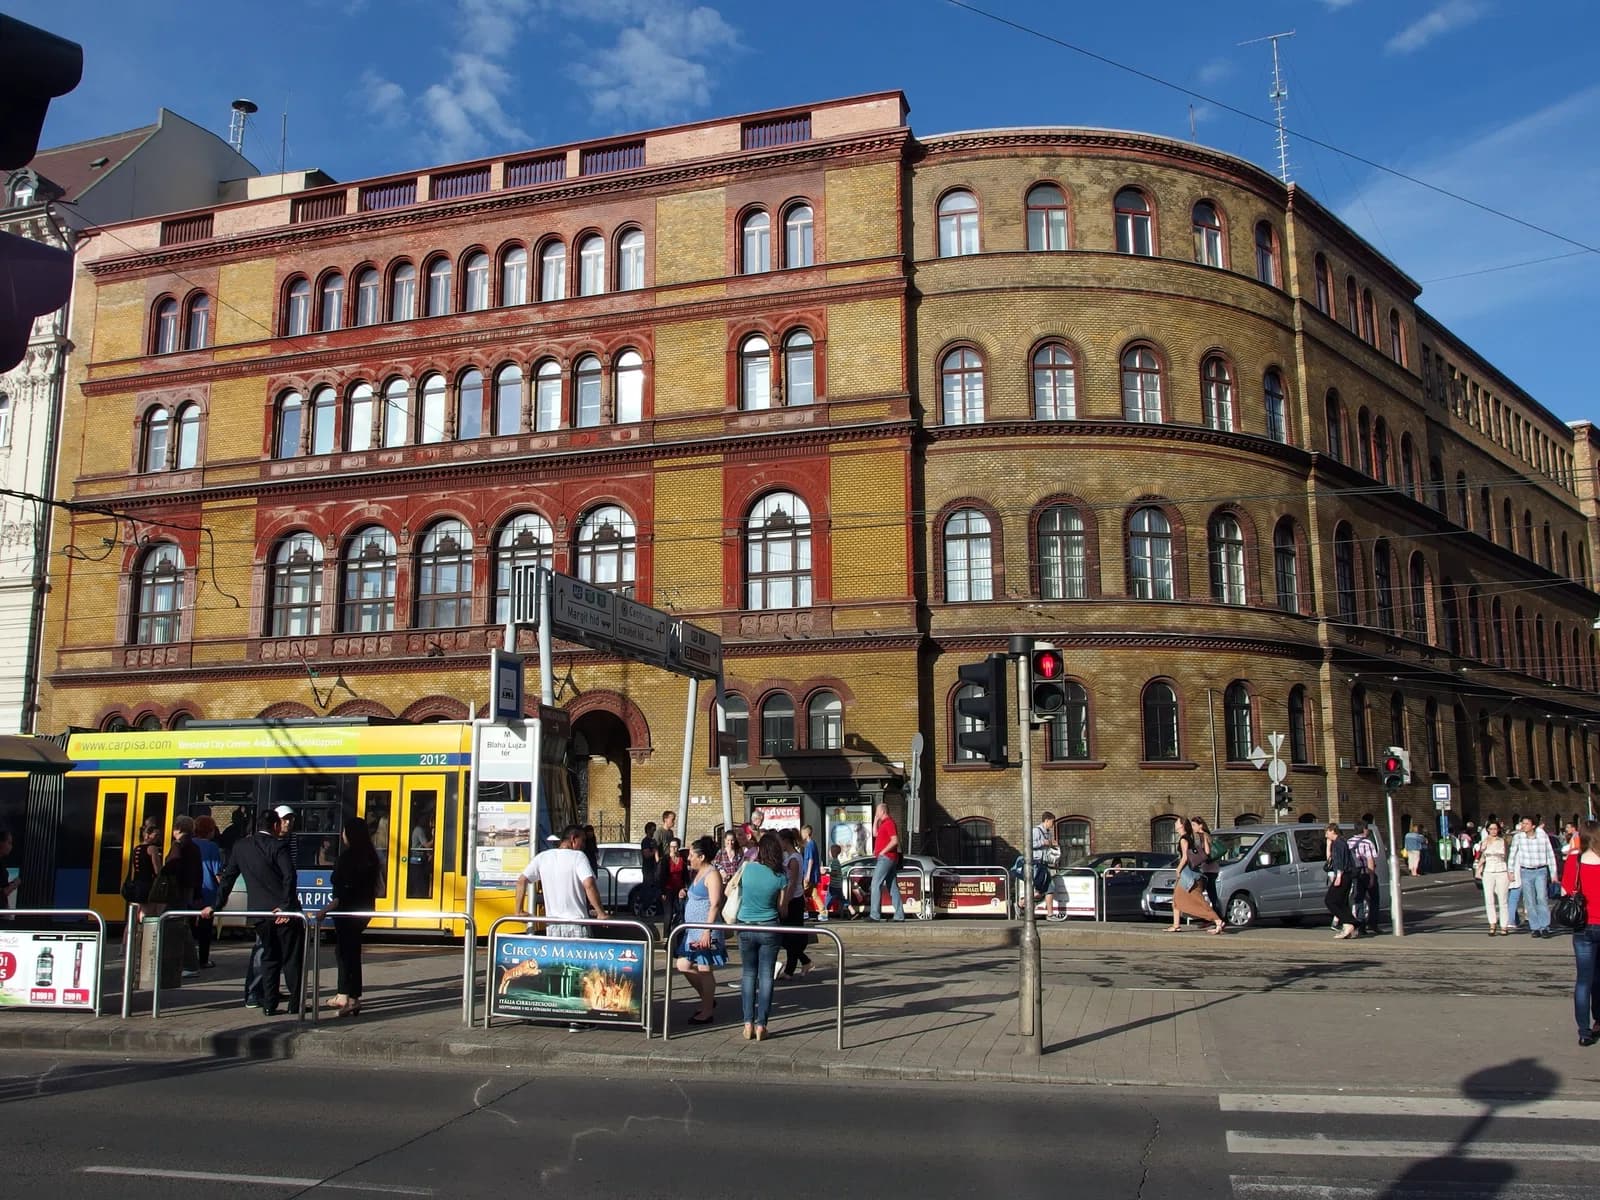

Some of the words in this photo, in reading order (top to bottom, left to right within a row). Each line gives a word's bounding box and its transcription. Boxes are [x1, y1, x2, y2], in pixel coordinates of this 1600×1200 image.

[567, 606, 588, 624] Margit
[81, 740, 172, 752] www.carpisa.com
[487, 741, 506, 749] Blaha
[508, 741, 527, 750] Lujza
[420, 754, 447, 765] 2012
